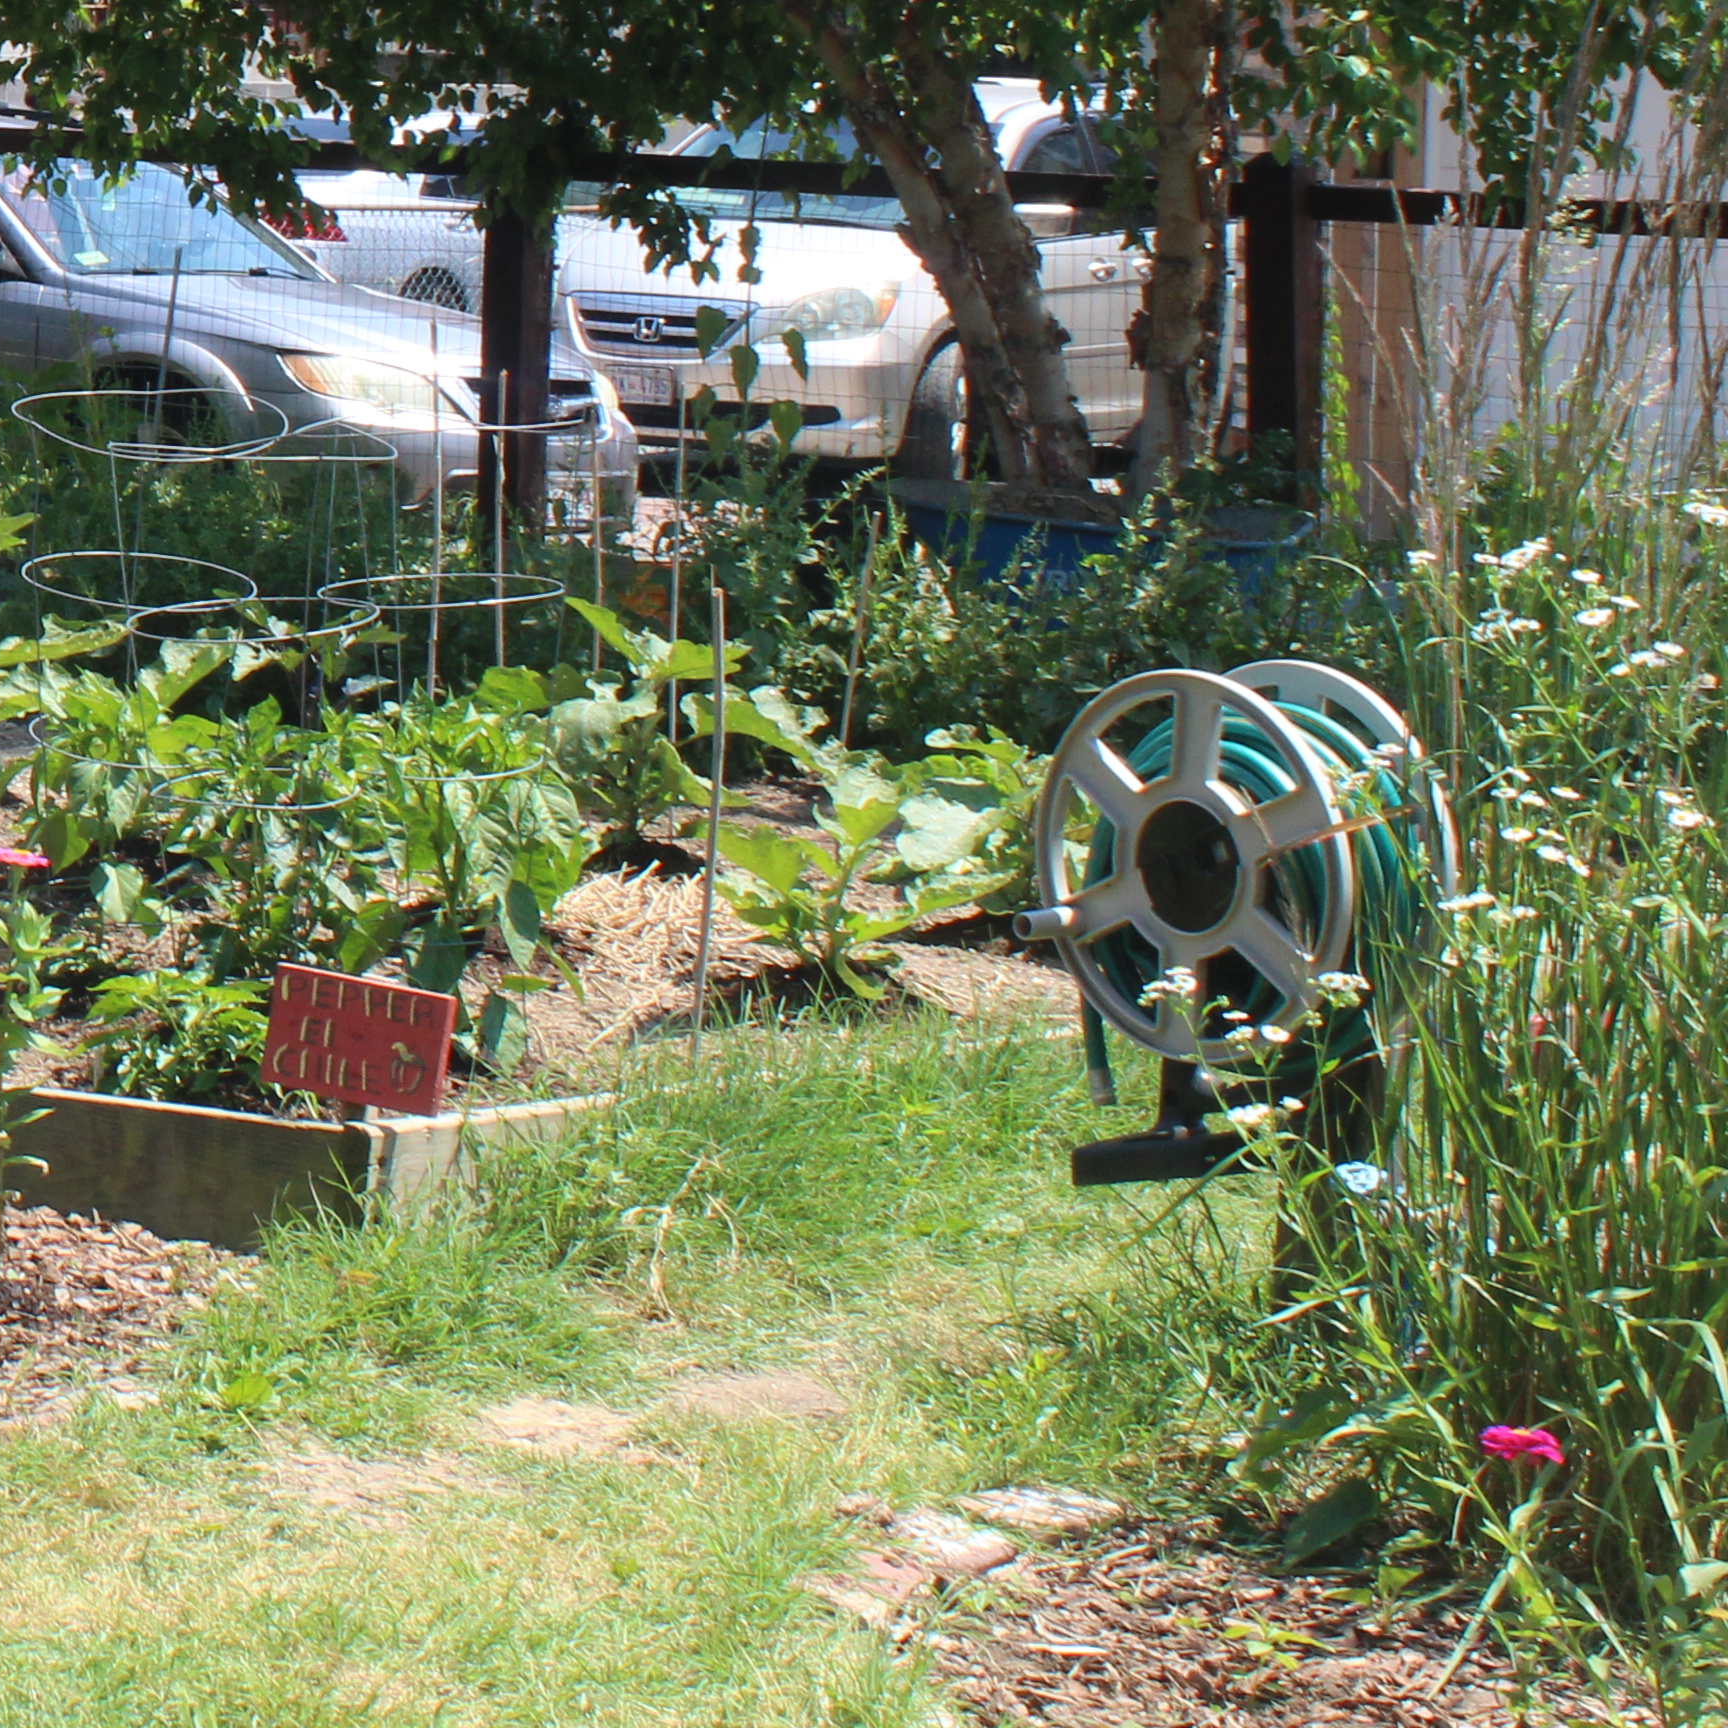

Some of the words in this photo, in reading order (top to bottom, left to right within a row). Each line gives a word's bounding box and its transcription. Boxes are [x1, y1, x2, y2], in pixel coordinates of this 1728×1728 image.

[280, 972, 438, 1028] PEPPER
[299, 1015, 343, 1052] EL
[272, 1043, 383, 1096] CHILE
